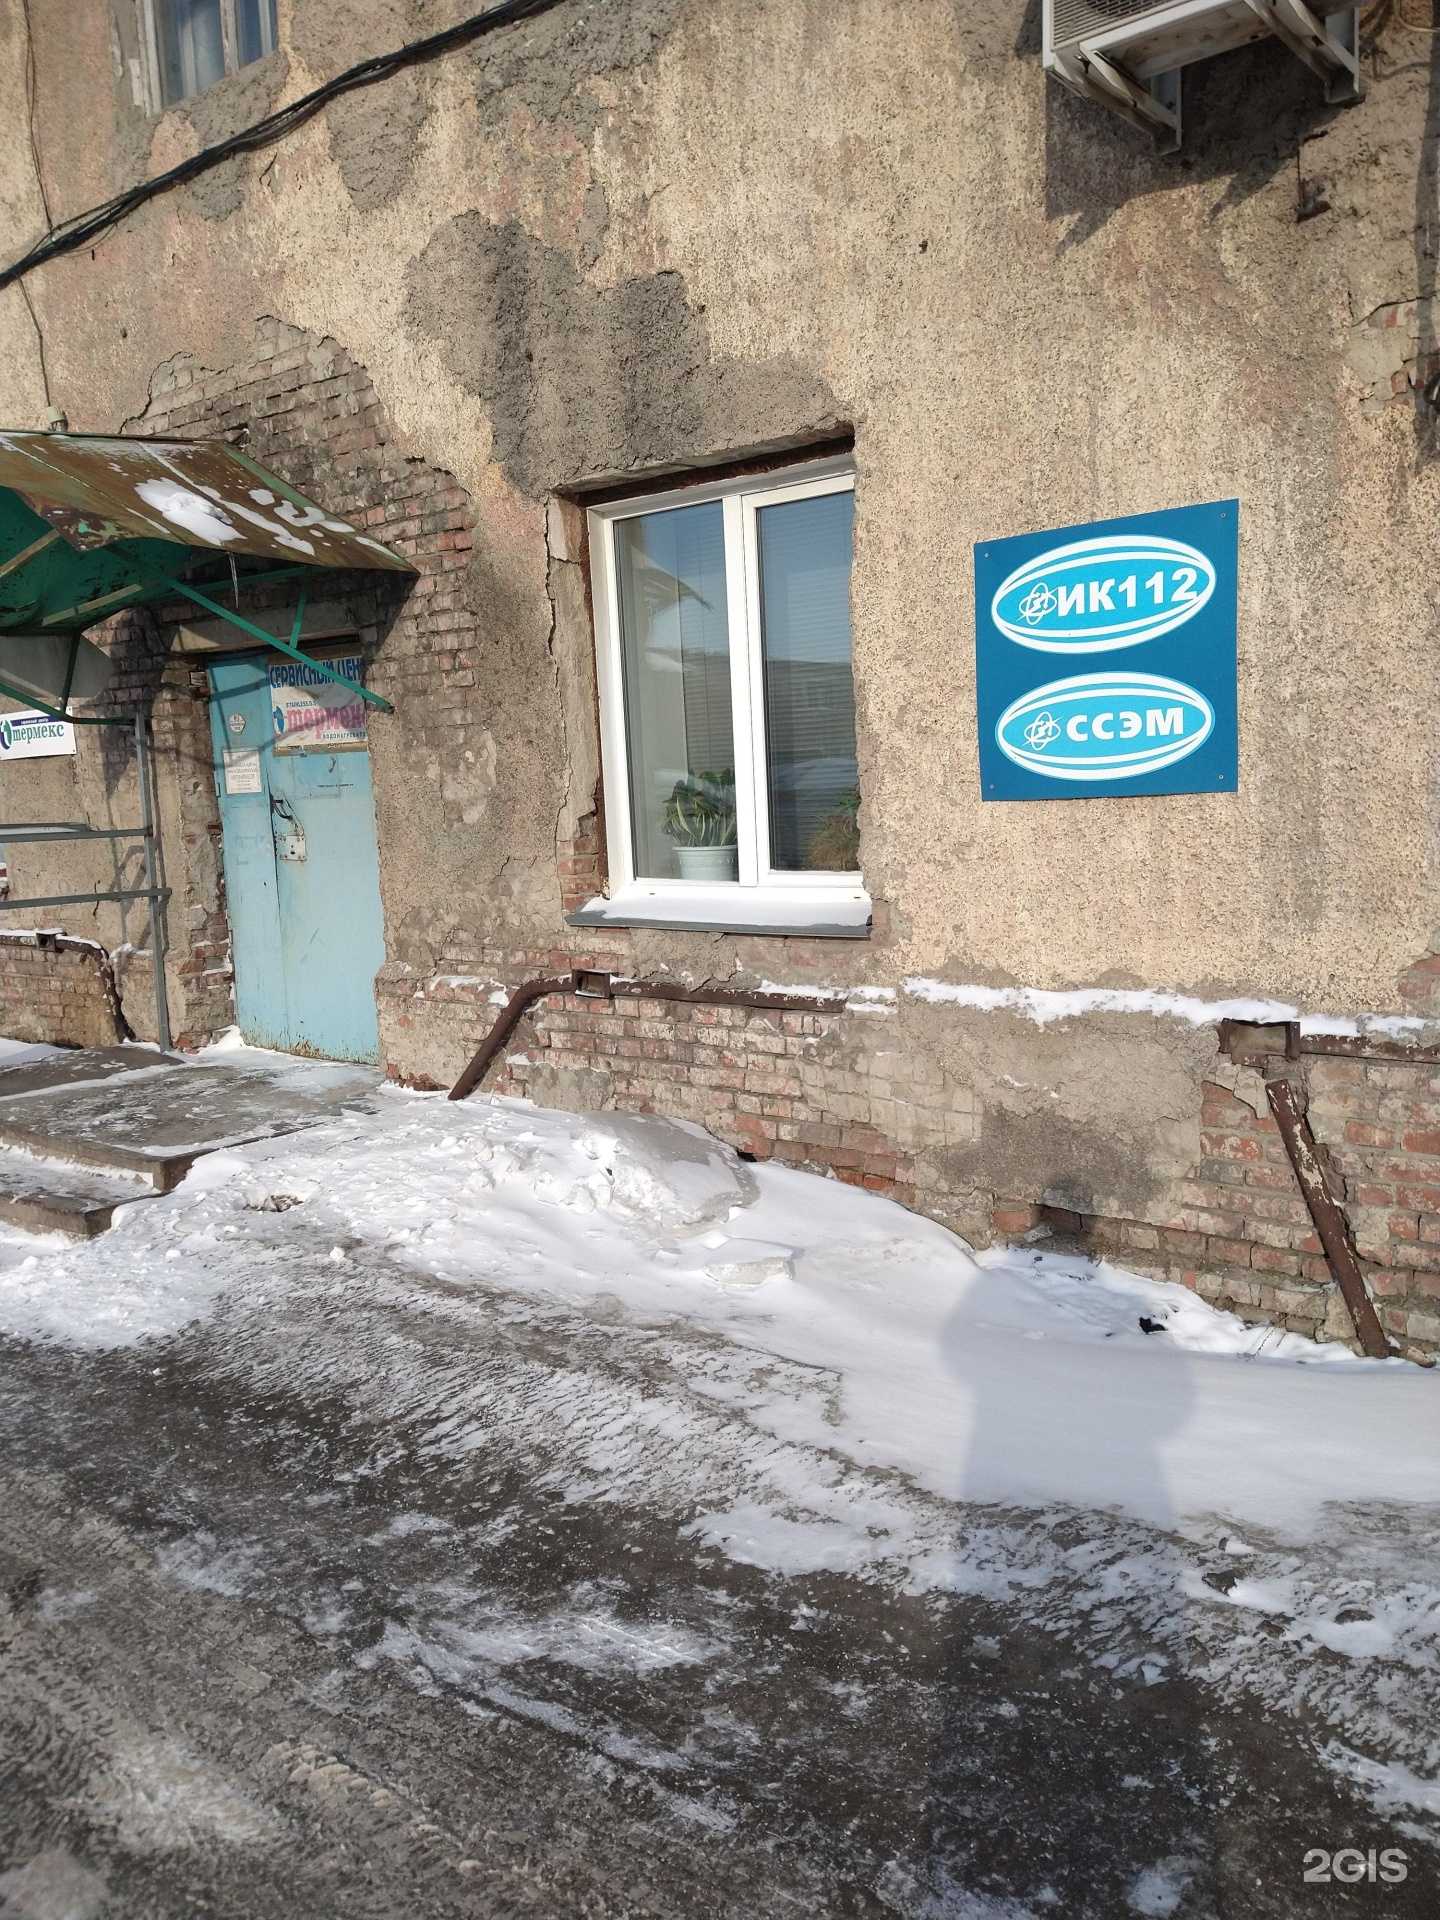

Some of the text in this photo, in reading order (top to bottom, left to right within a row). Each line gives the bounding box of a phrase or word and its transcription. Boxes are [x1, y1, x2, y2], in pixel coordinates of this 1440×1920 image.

[1058, 567, 1199, 617] ИК112
[12, 724, 65, 744] термекс
[1066, 707, 1184, 742] ССЭМ
